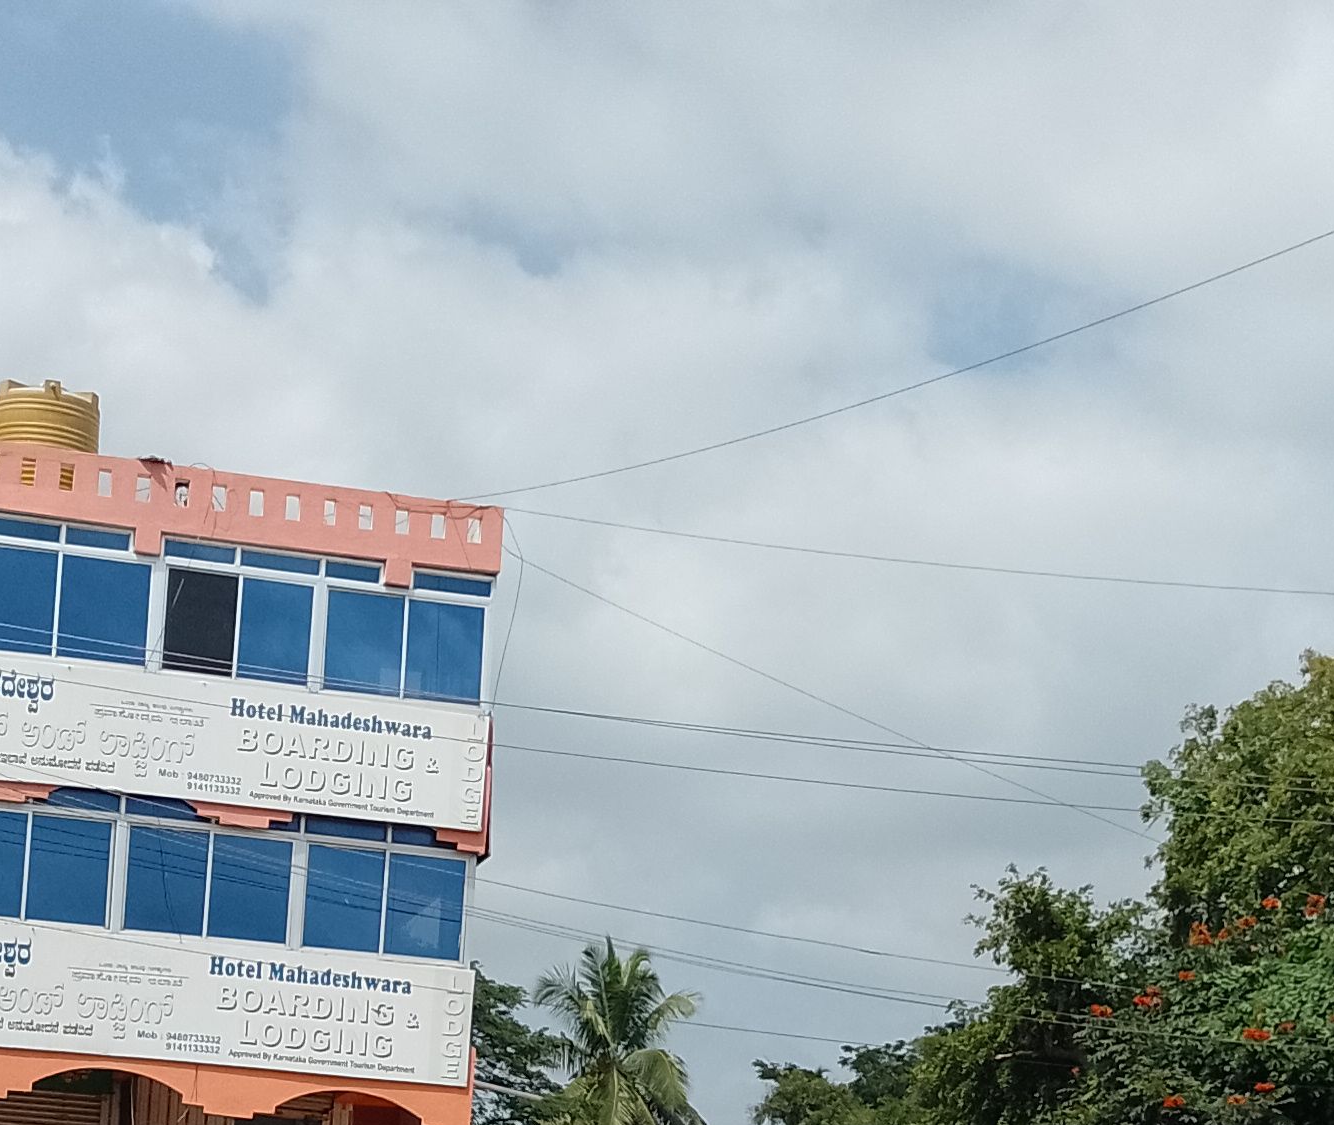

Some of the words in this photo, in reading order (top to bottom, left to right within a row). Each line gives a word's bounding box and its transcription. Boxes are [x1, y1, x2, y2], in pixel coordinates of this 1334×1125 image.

[230, 698, 284, 722] Hotel
[289, 705, 433, 740] Mahadeshwara
[236, 728, 416, 770] BOARDING
[157, 769, 179, 780] Mob
[186, 771, 243, 786] 9480733332
[186, 781, 242, 796] 9141133332
[259, 762, 415, 802] LODGING
[249, 790, 282, 803] Approved
[283, 793, 293, 804] By
[209, 956, 263, 980] Hotel
[268, 962, 414, 995] Mahadeshwara
[215, 986, 396, 1027] BOARDING
[137, 1029, 158, 1040] Mob
[165, 1032, 223, 1045] 9480733332
[165, 1042, 222, 1055] 9141133332
[238, 1020, 395, 1058] LODGING
[227, 1049, 261, 1061] Approved
[262, 1052, 272, 1063] By
[308, 1057, 349, 1068] Government
